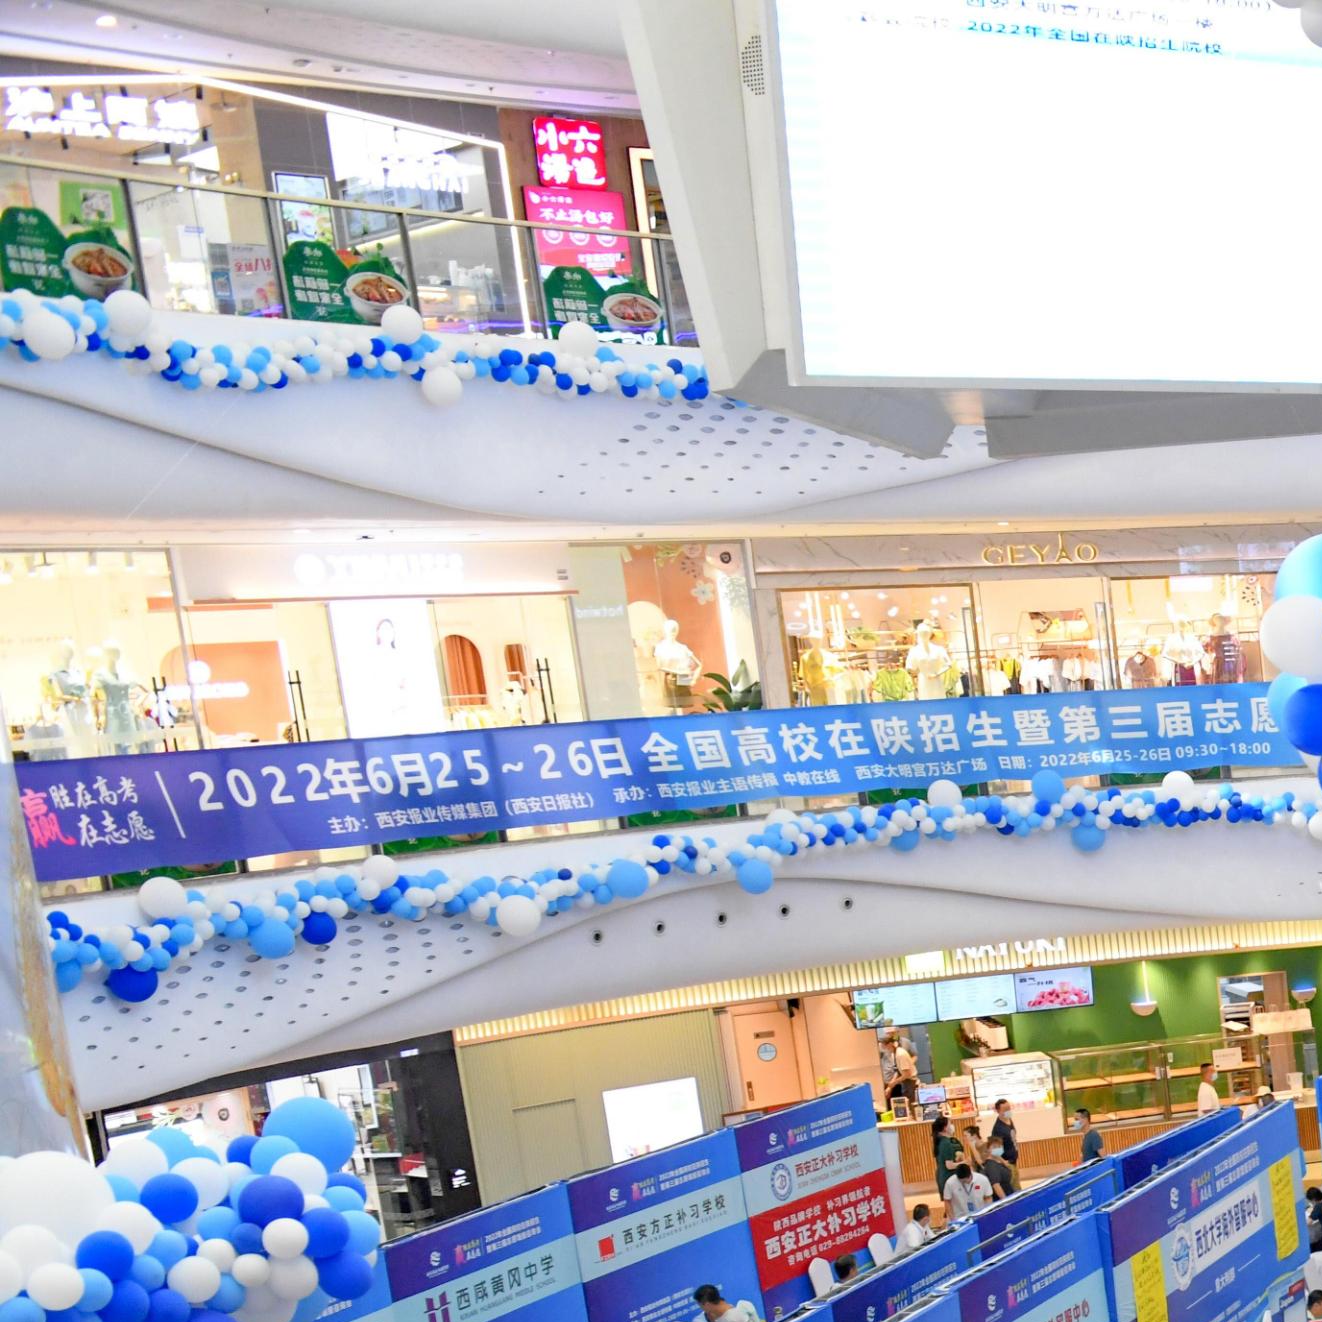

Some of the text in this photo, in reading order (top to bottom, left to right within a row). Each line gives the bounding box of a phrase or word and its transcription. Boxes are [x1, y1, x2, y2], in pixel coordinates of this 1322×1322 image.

[538, 122, 601, 153] 小六
[795, 1143, 860, 1178] 西安正大补习学校
[623, 1193, 727, 1246] 西安方正补习学校
[764, 1196, 888, 1260] 西安正大补习学校
[456, 1255, 554, 1311] 西咸黄冈中学
